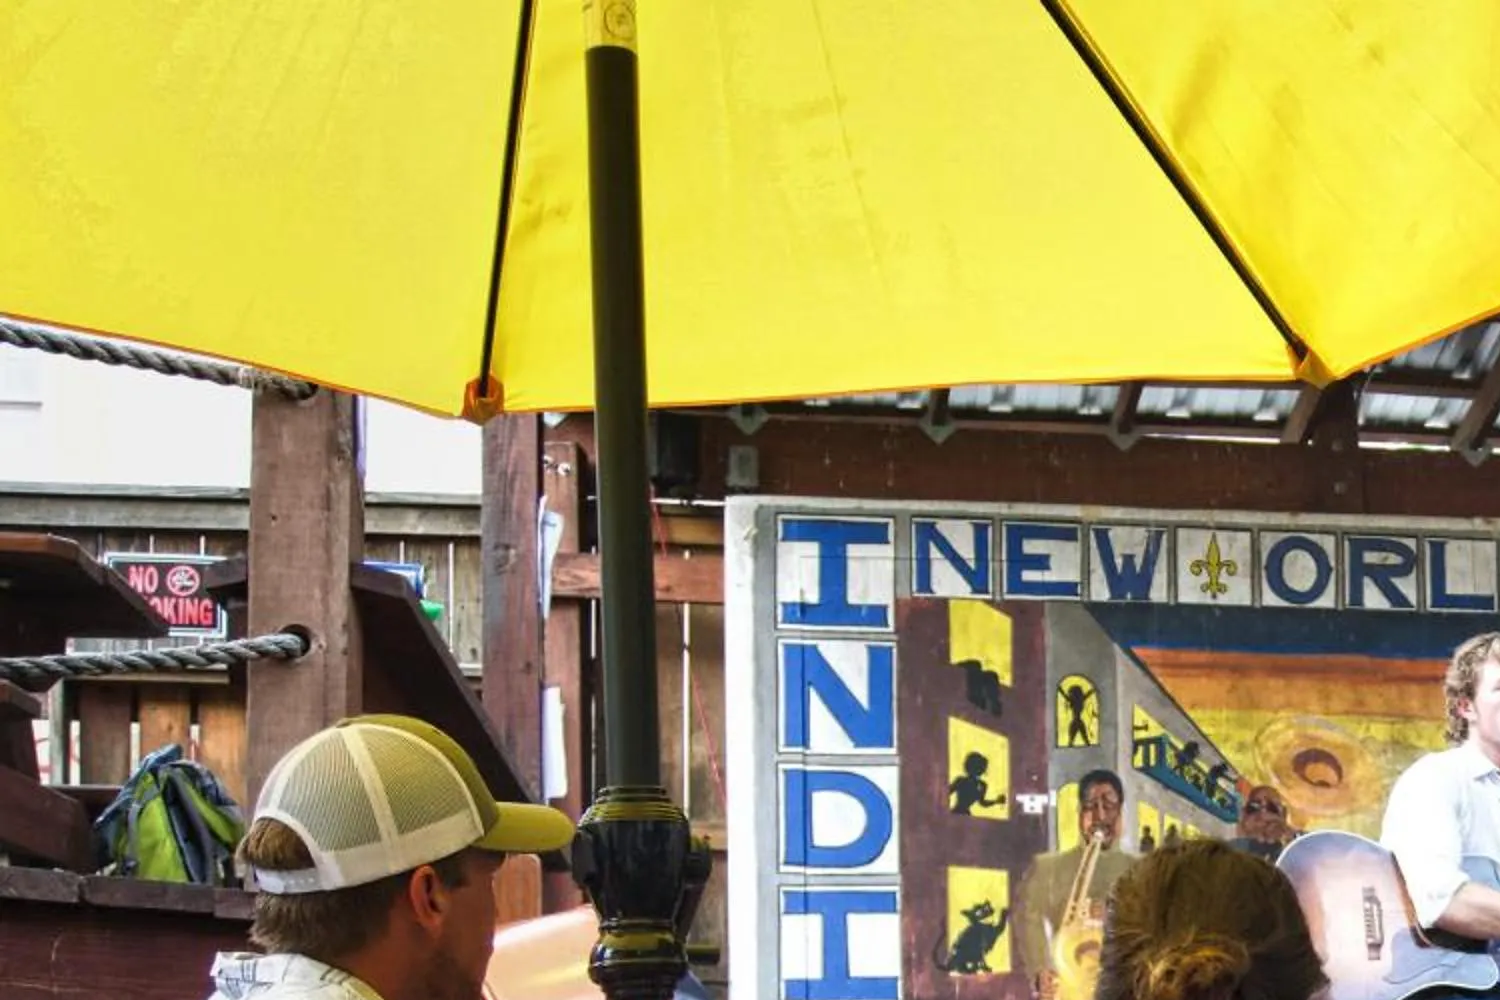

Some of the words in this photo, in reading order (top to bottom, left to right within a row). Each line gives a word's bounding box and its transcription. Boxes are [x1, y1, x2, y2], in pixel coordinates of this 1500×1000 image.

[912, 519, 1168, 601] NEW
[127, 564, 159, 594] NO
[149, 595, 214, 626] OKING
